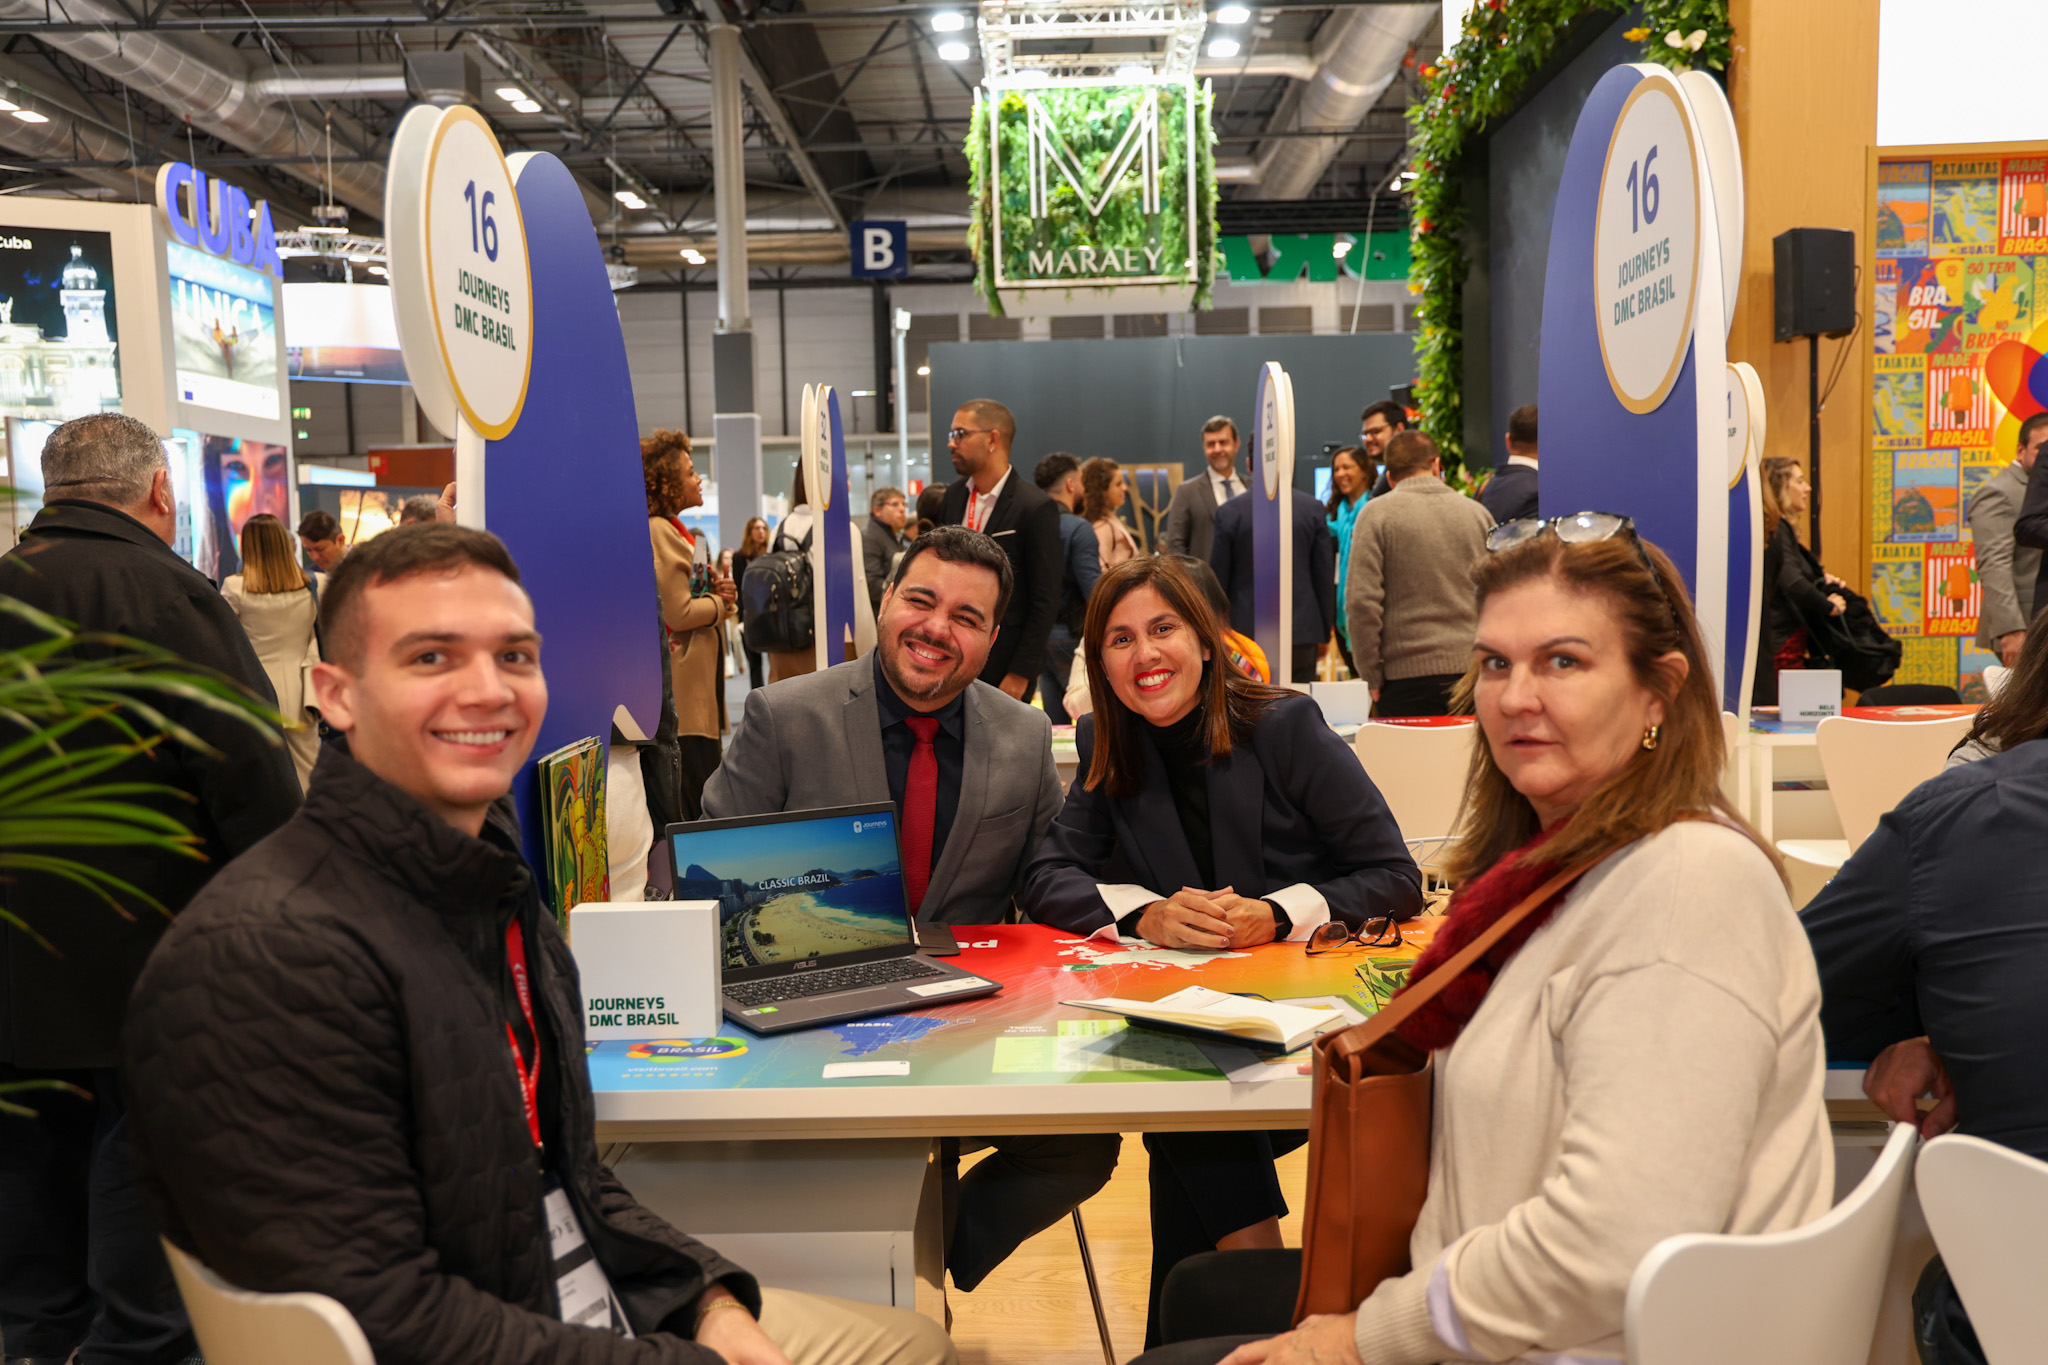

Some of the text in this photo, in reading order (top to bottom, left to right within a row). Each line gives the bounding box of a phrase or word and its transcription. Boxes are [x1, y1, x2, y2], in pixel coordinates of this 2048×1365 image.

[1626, 144, 1660, 234] 16
[157, 161, 285, 277] CUBA
[463, 179, 498, 263] 16
[863, 227, 895, 271] B
[1029, 246, 1165, 275] MARAEY
[1618, 237, 1670, 289] JOURNEYS
[1988, 261, 2016, 274] TEM
[458, 268, 510, 315] JOURNEYS
[1614, 274, 1675, 326] DMC BRASIL
[1908, 285, 1947, 306] BRA
[455, 303, 516, 351] DMC BRASIL
[1908, 309, 1942, 330] SIL
[1930, 430, 1989, 447] BRASIL
[1896, 451, 1957, 469] BRASIL
[758, 873, 830, 891] CLASSIC BRAZIL
[589, 997, 665, 1011] JOURNEYS
[589, 1012, 679, 1027] DMC BRASIL
[657, 1045, 723, 1054] BRASIL
